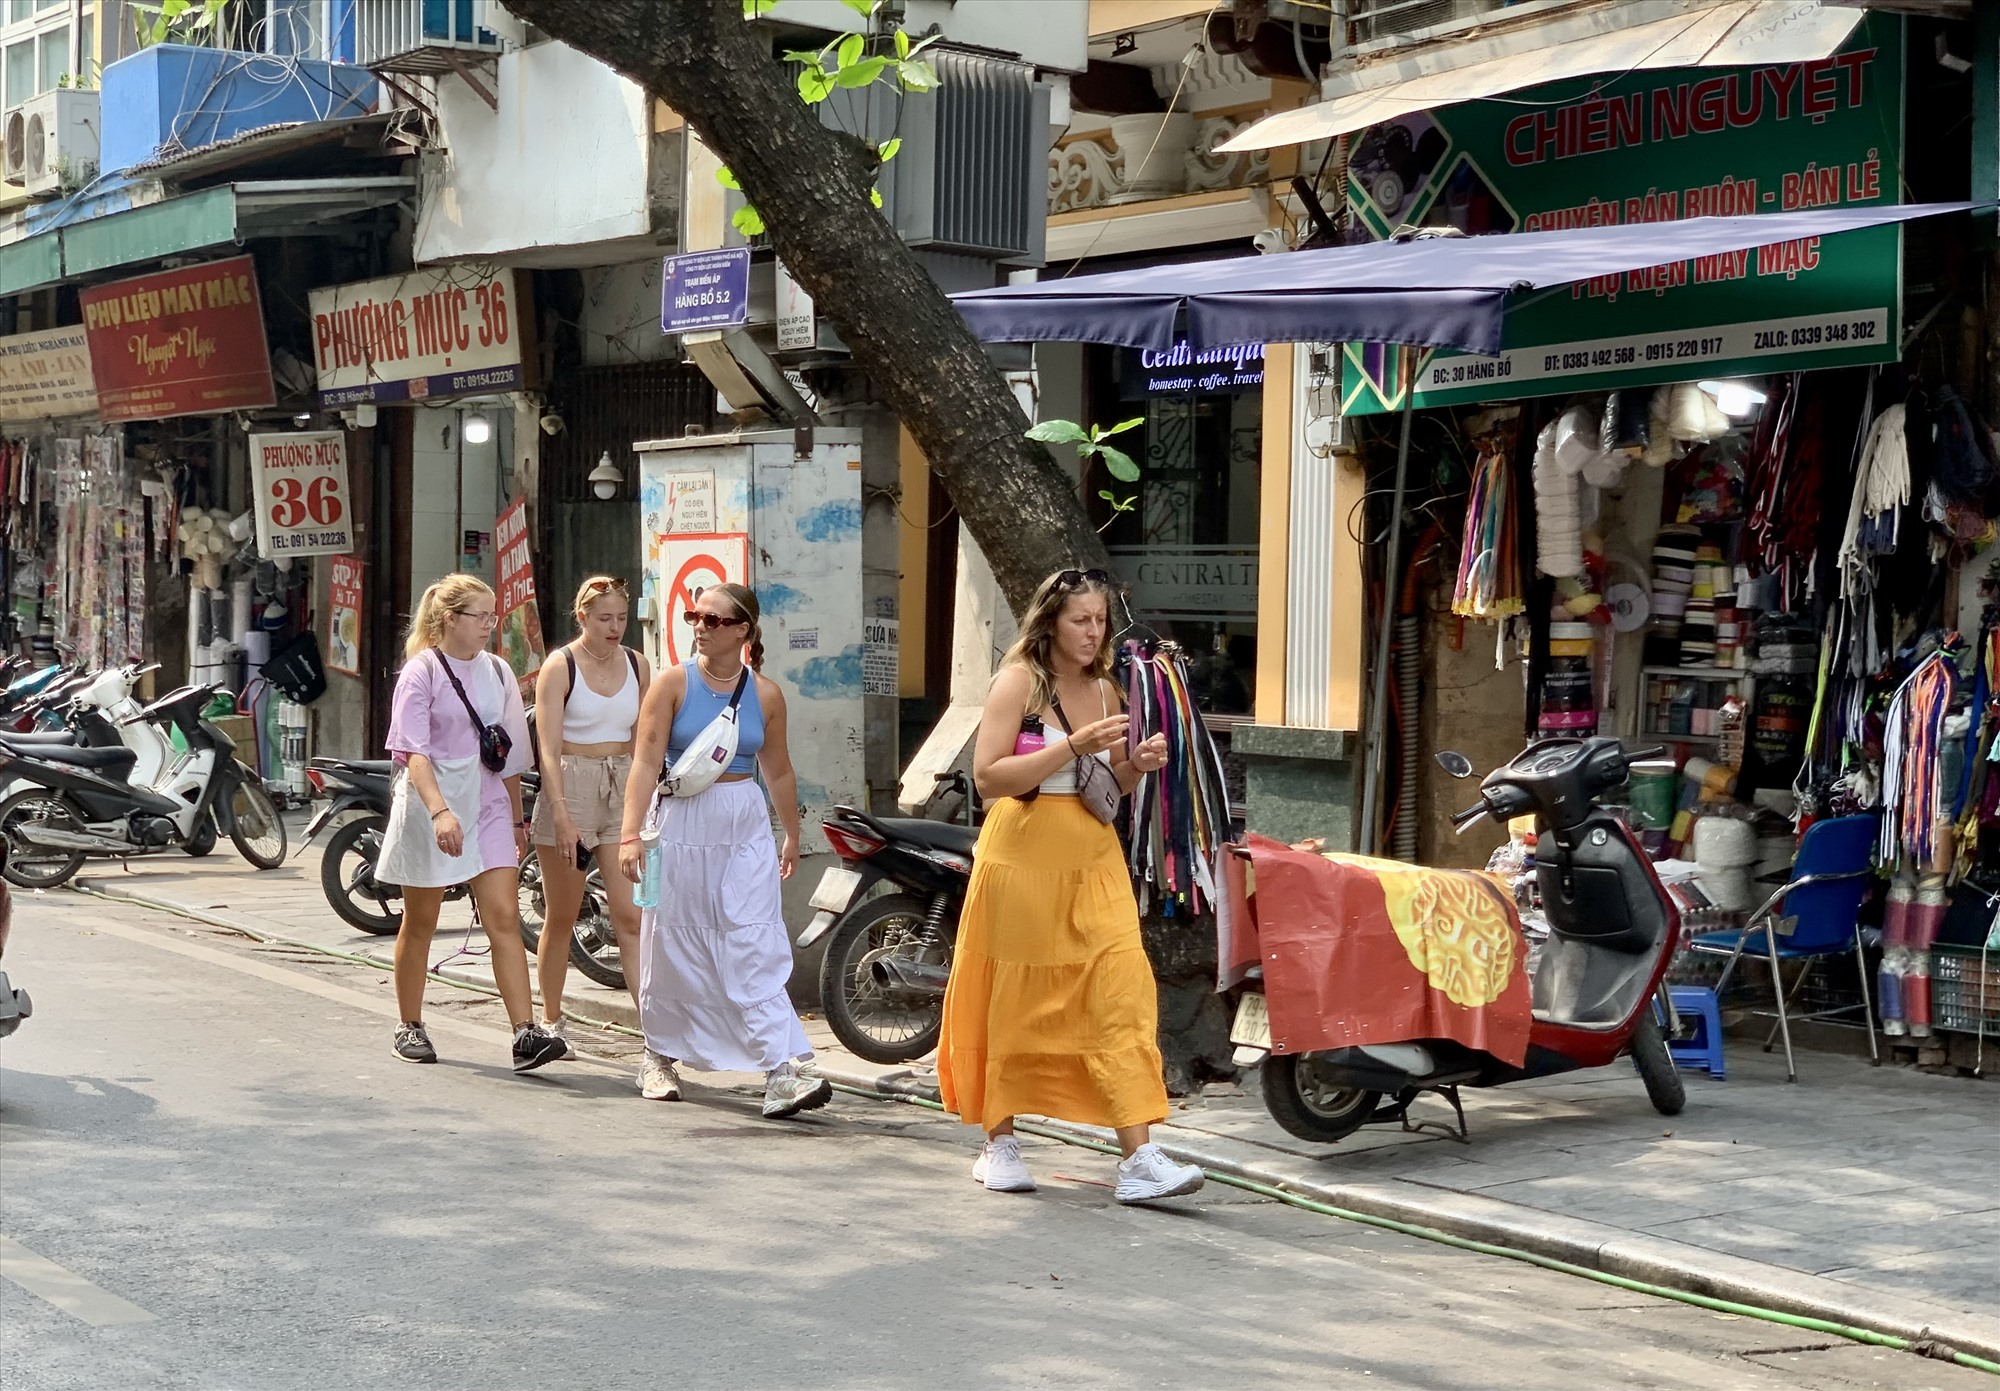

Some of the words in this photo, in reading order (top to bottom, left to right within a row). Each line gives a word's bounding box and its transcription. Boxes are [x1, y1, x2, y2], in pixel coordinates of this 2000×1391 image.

[1504, 80, 1642, 167] CHIẾN
[1684, 175, 1757, 218] BUÔN
[1782, 162, 1840, 211] BÁN
[1847, 148, 1881, 202] LẺ
[712, 274, 721, 284] ÁP
[86, 298, 121, 330] PHỤ
[122, 287, 161, 325] LIỆU
[162, 282, 203, 315] MAY
[205, 271, 251, 311] MẶC
[675, 291, 699, 309] HÀNG
[700, 287, 714, 306] BỒ
[716, 290, 730, 304] 5.2
[316, 298, 410, 378] PHƯỢNG
[412, 283, 470, 367] MỰC
[475, 281, 509, 348] 36
[1754, 330, 1788, 350] ZALO:
[1791, 326, 1821, 346] 0339
[1825, 323, 1848, 342] 348
[1852, 320, 1876, 340] 302
[1544, 357, 1560, 372] ĐT:
[1563, 352, 1588, 370] 0383
[1591, 349, 1612, 367] 492
[1614, 346, 1635, 364] 568
[1645, 342, 1673, 361] 0915
[1676, 340, 1698, 358] 220
[1701, 337, 1723, 354] 917
[453, 375, 466, 389] ĐT:
[467, 370, 514, 387] 09154.22236
[1452, 367, 1464, 382] 30
[1466, 361, 1495, 380] HÀNG
[263, 442, 313, 473] PHƯỢNG
[316, 440, 340, 471] MỰC
[271, 476, 342, 528] 36
[272, 535, 289, 549] TEL:
[290, 534, 305, 547] 091
[308, 533, 319, 546] 54
[321, 531, 346, 546] 22236
